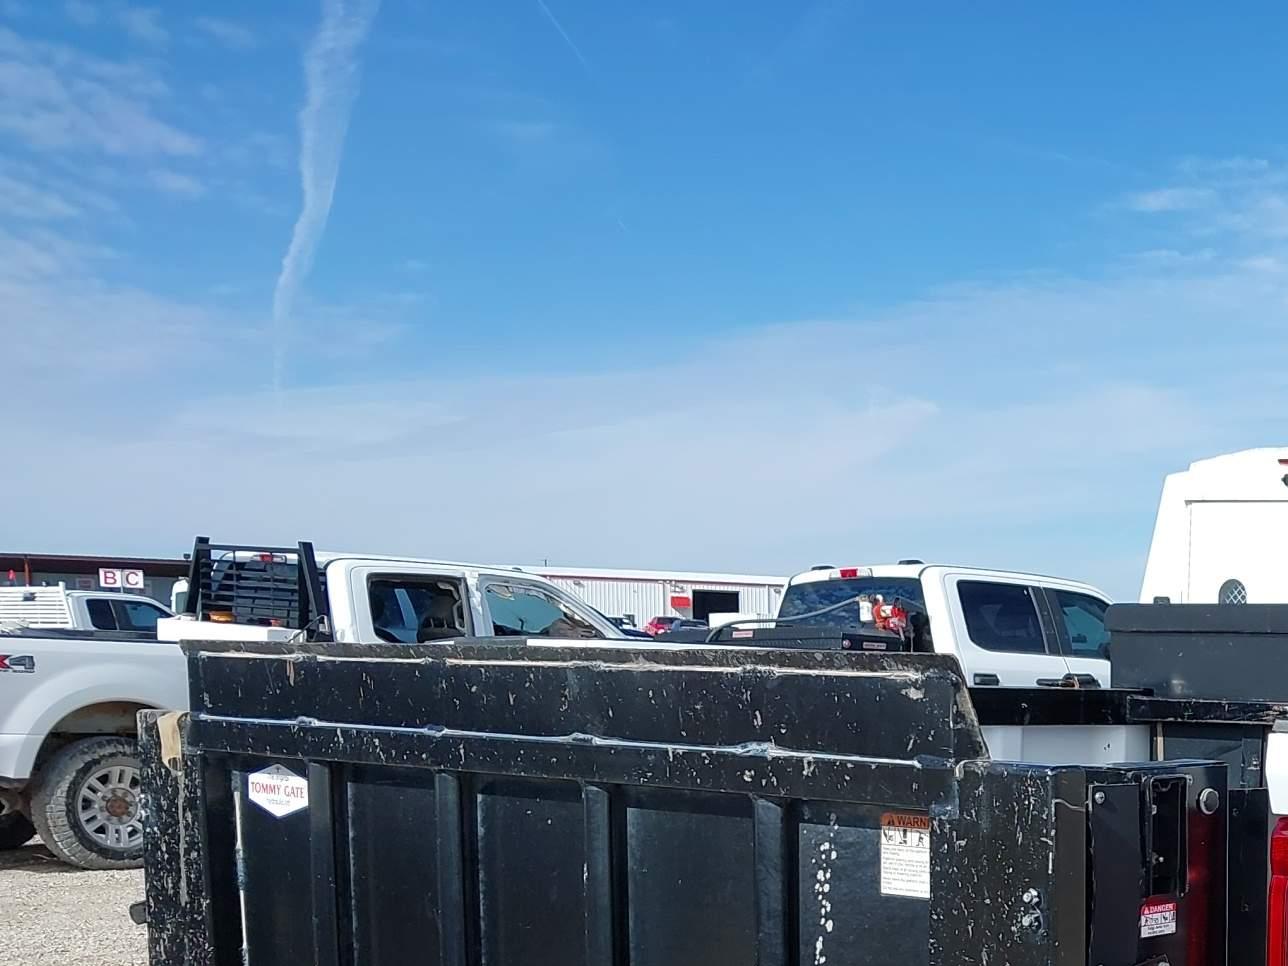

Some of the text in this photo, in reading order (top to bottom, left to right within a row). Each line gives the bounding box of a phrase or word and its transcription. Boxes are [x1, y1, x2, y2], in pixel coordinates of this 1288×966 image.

[103, 570, 139, 586] B C
[251, 781, 305, 799] TOMMY GATE
[896, 815, 929, 828] WARN
[1150, 902, 1177, 914] DANGER
